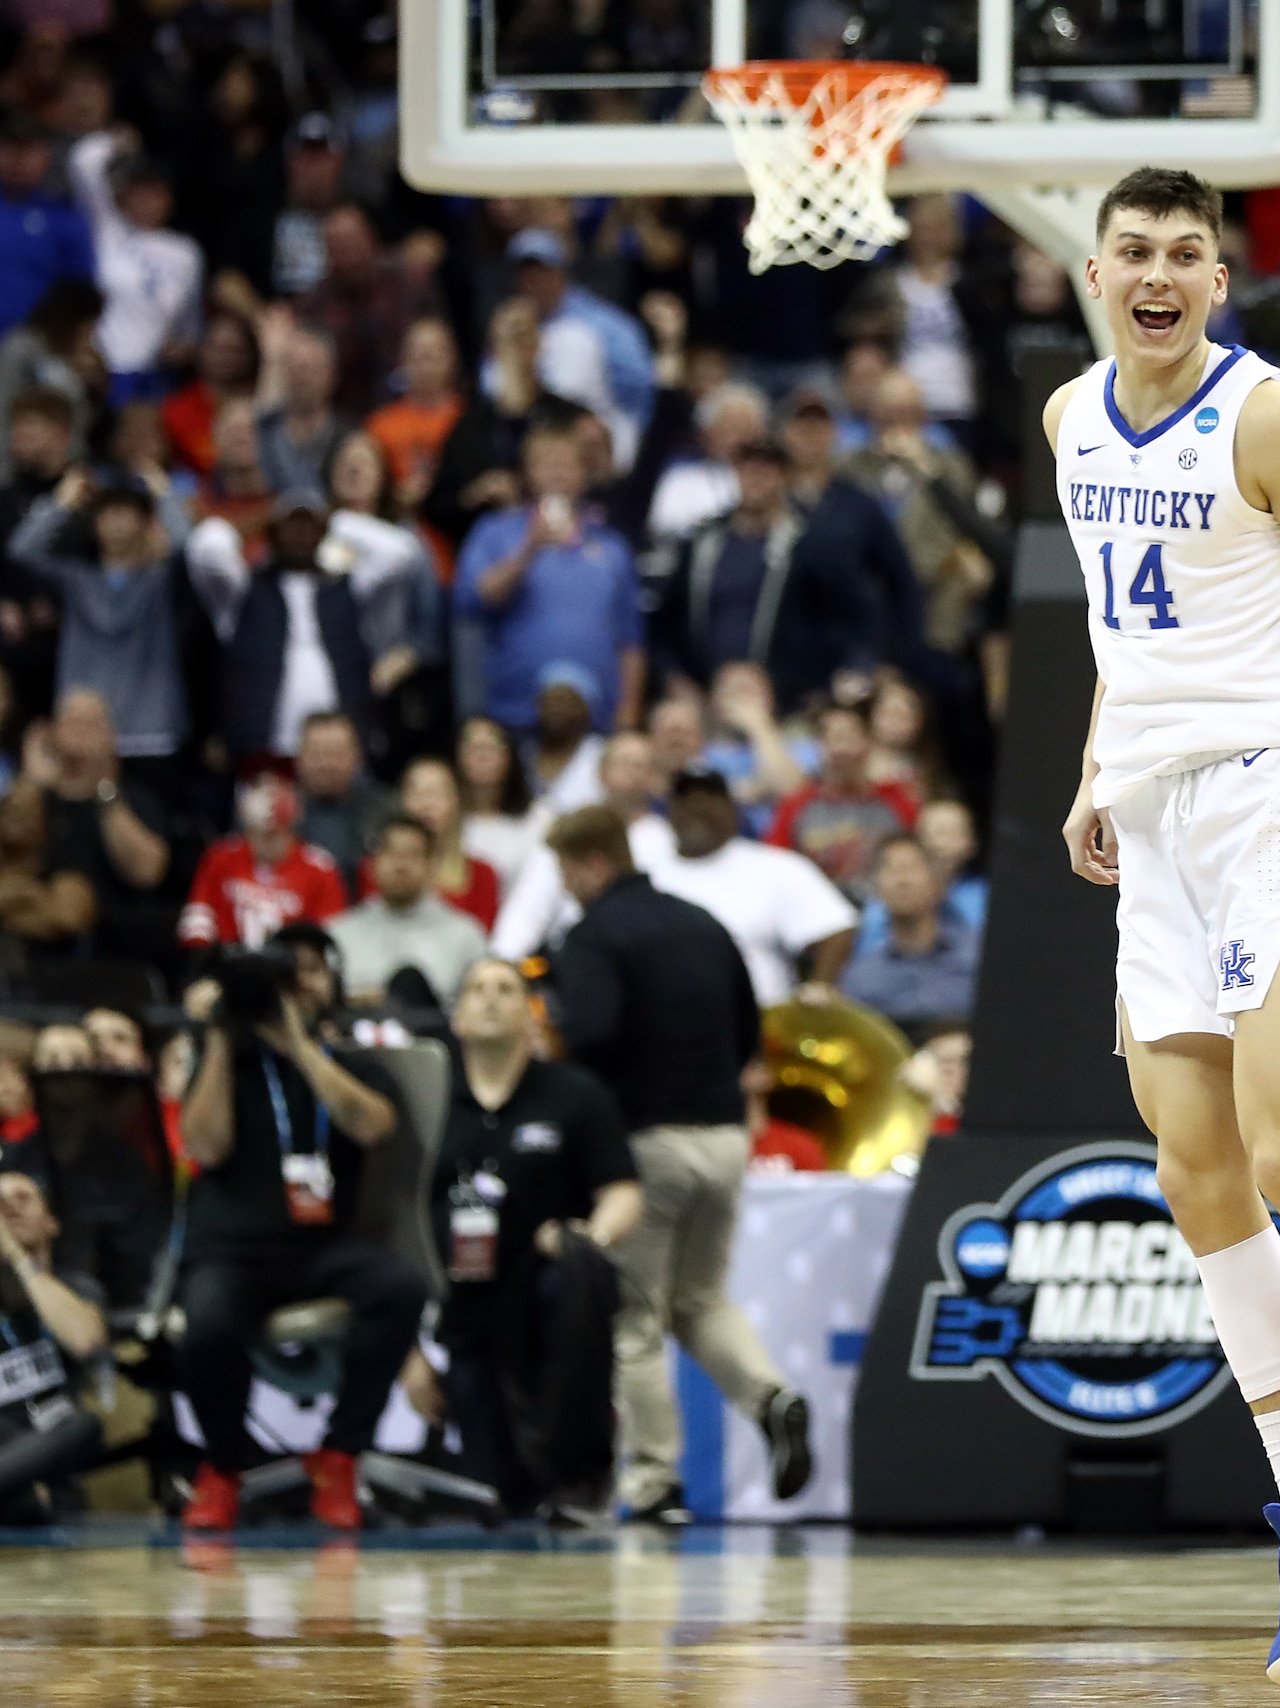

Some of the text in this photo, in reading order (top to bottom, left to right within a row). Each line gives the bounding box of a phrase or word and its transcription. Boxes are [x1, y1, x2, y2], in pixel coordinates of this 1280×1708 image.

[1179, 449, 1198, 469] SEC
[1070, 483, 1216, 530] KENTUCKY
[1098, 541, 1180, 630] 14
